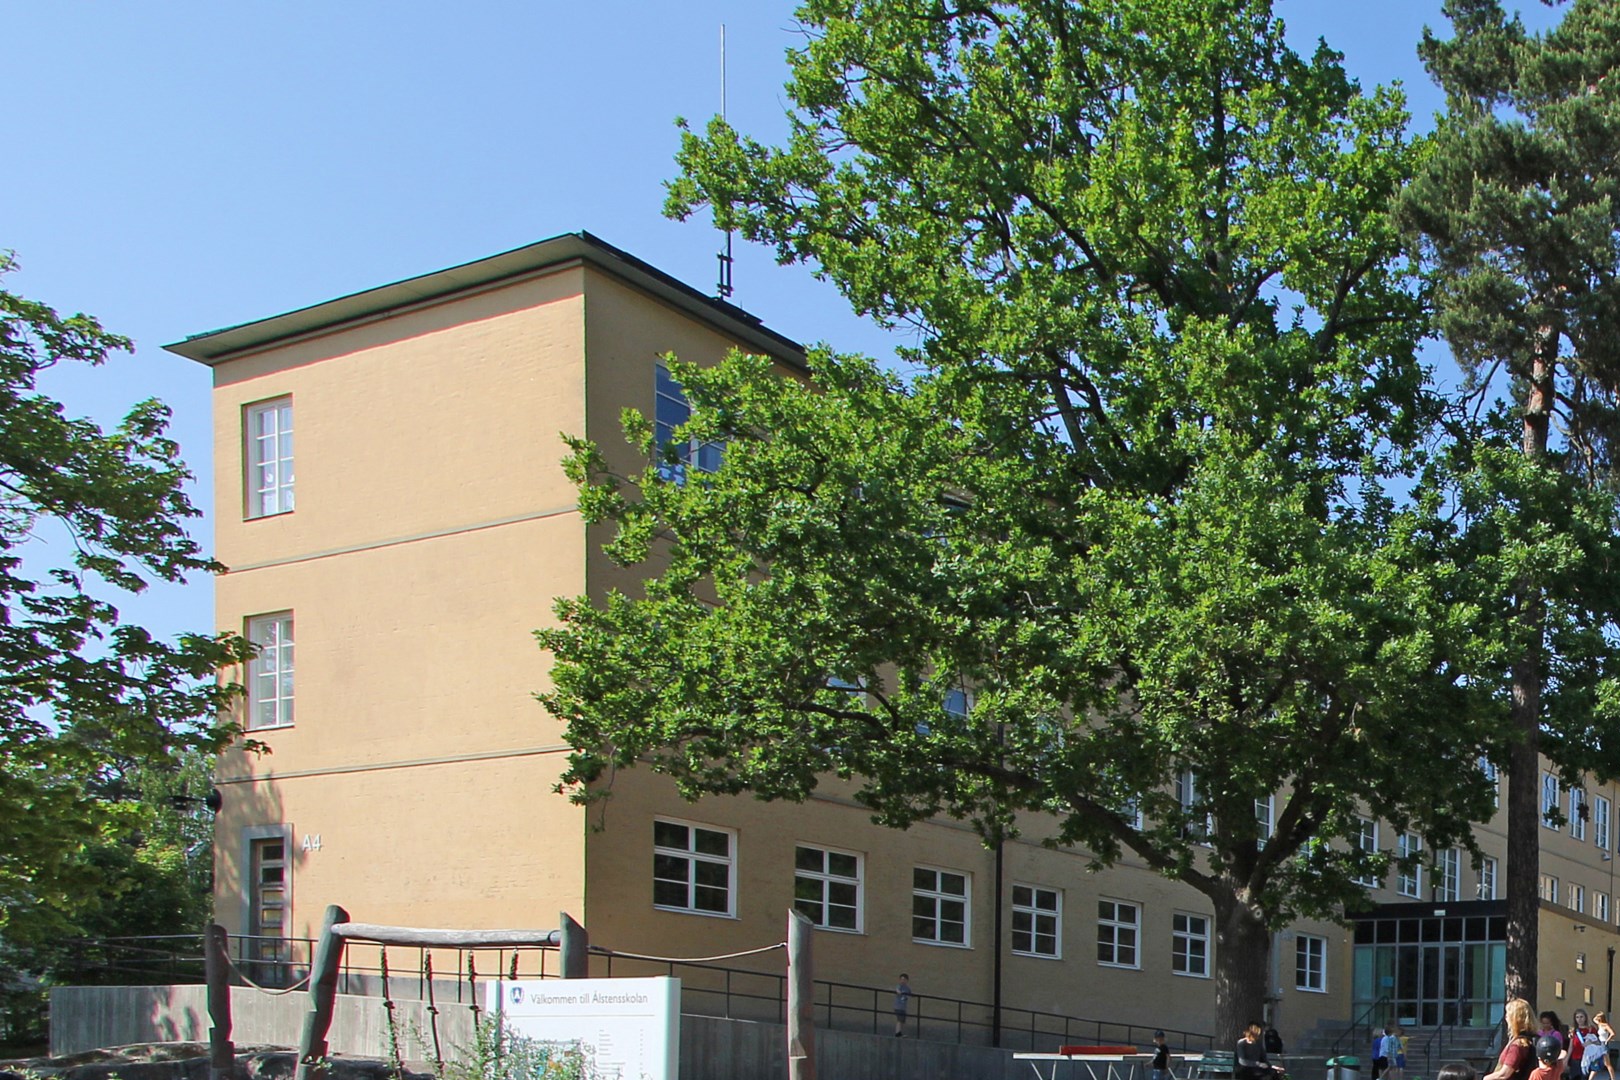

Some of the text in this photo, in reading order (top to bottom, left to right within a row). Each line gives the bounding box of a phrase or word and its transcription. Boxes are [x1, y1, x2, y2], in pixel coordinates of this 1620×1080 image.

[302, 834, 322, 851] A4
[530, 989, 649, 1005] Välkommen till Ålstensskolan
